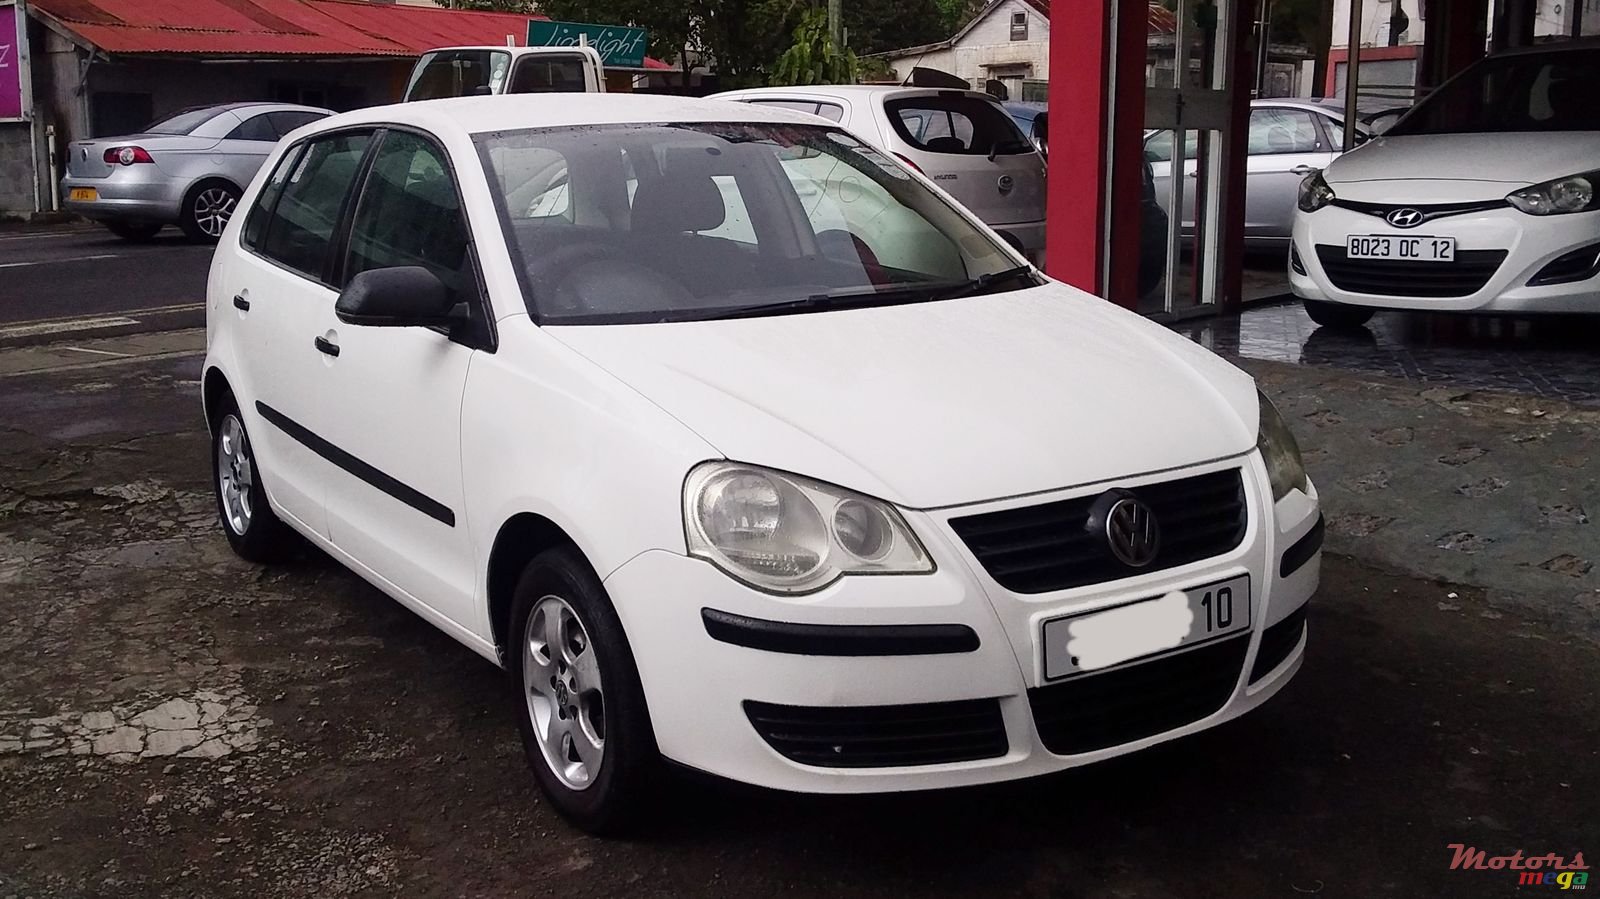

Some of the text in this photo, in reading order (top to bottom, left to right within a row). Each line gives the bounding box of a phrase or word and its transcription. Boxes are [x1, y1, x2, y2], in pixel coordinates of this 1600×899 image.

[1351, 238, 1391, 257] 8023
[1431, 240, 1450, 259] 12
[1201, 586, 1233, 632] 10
